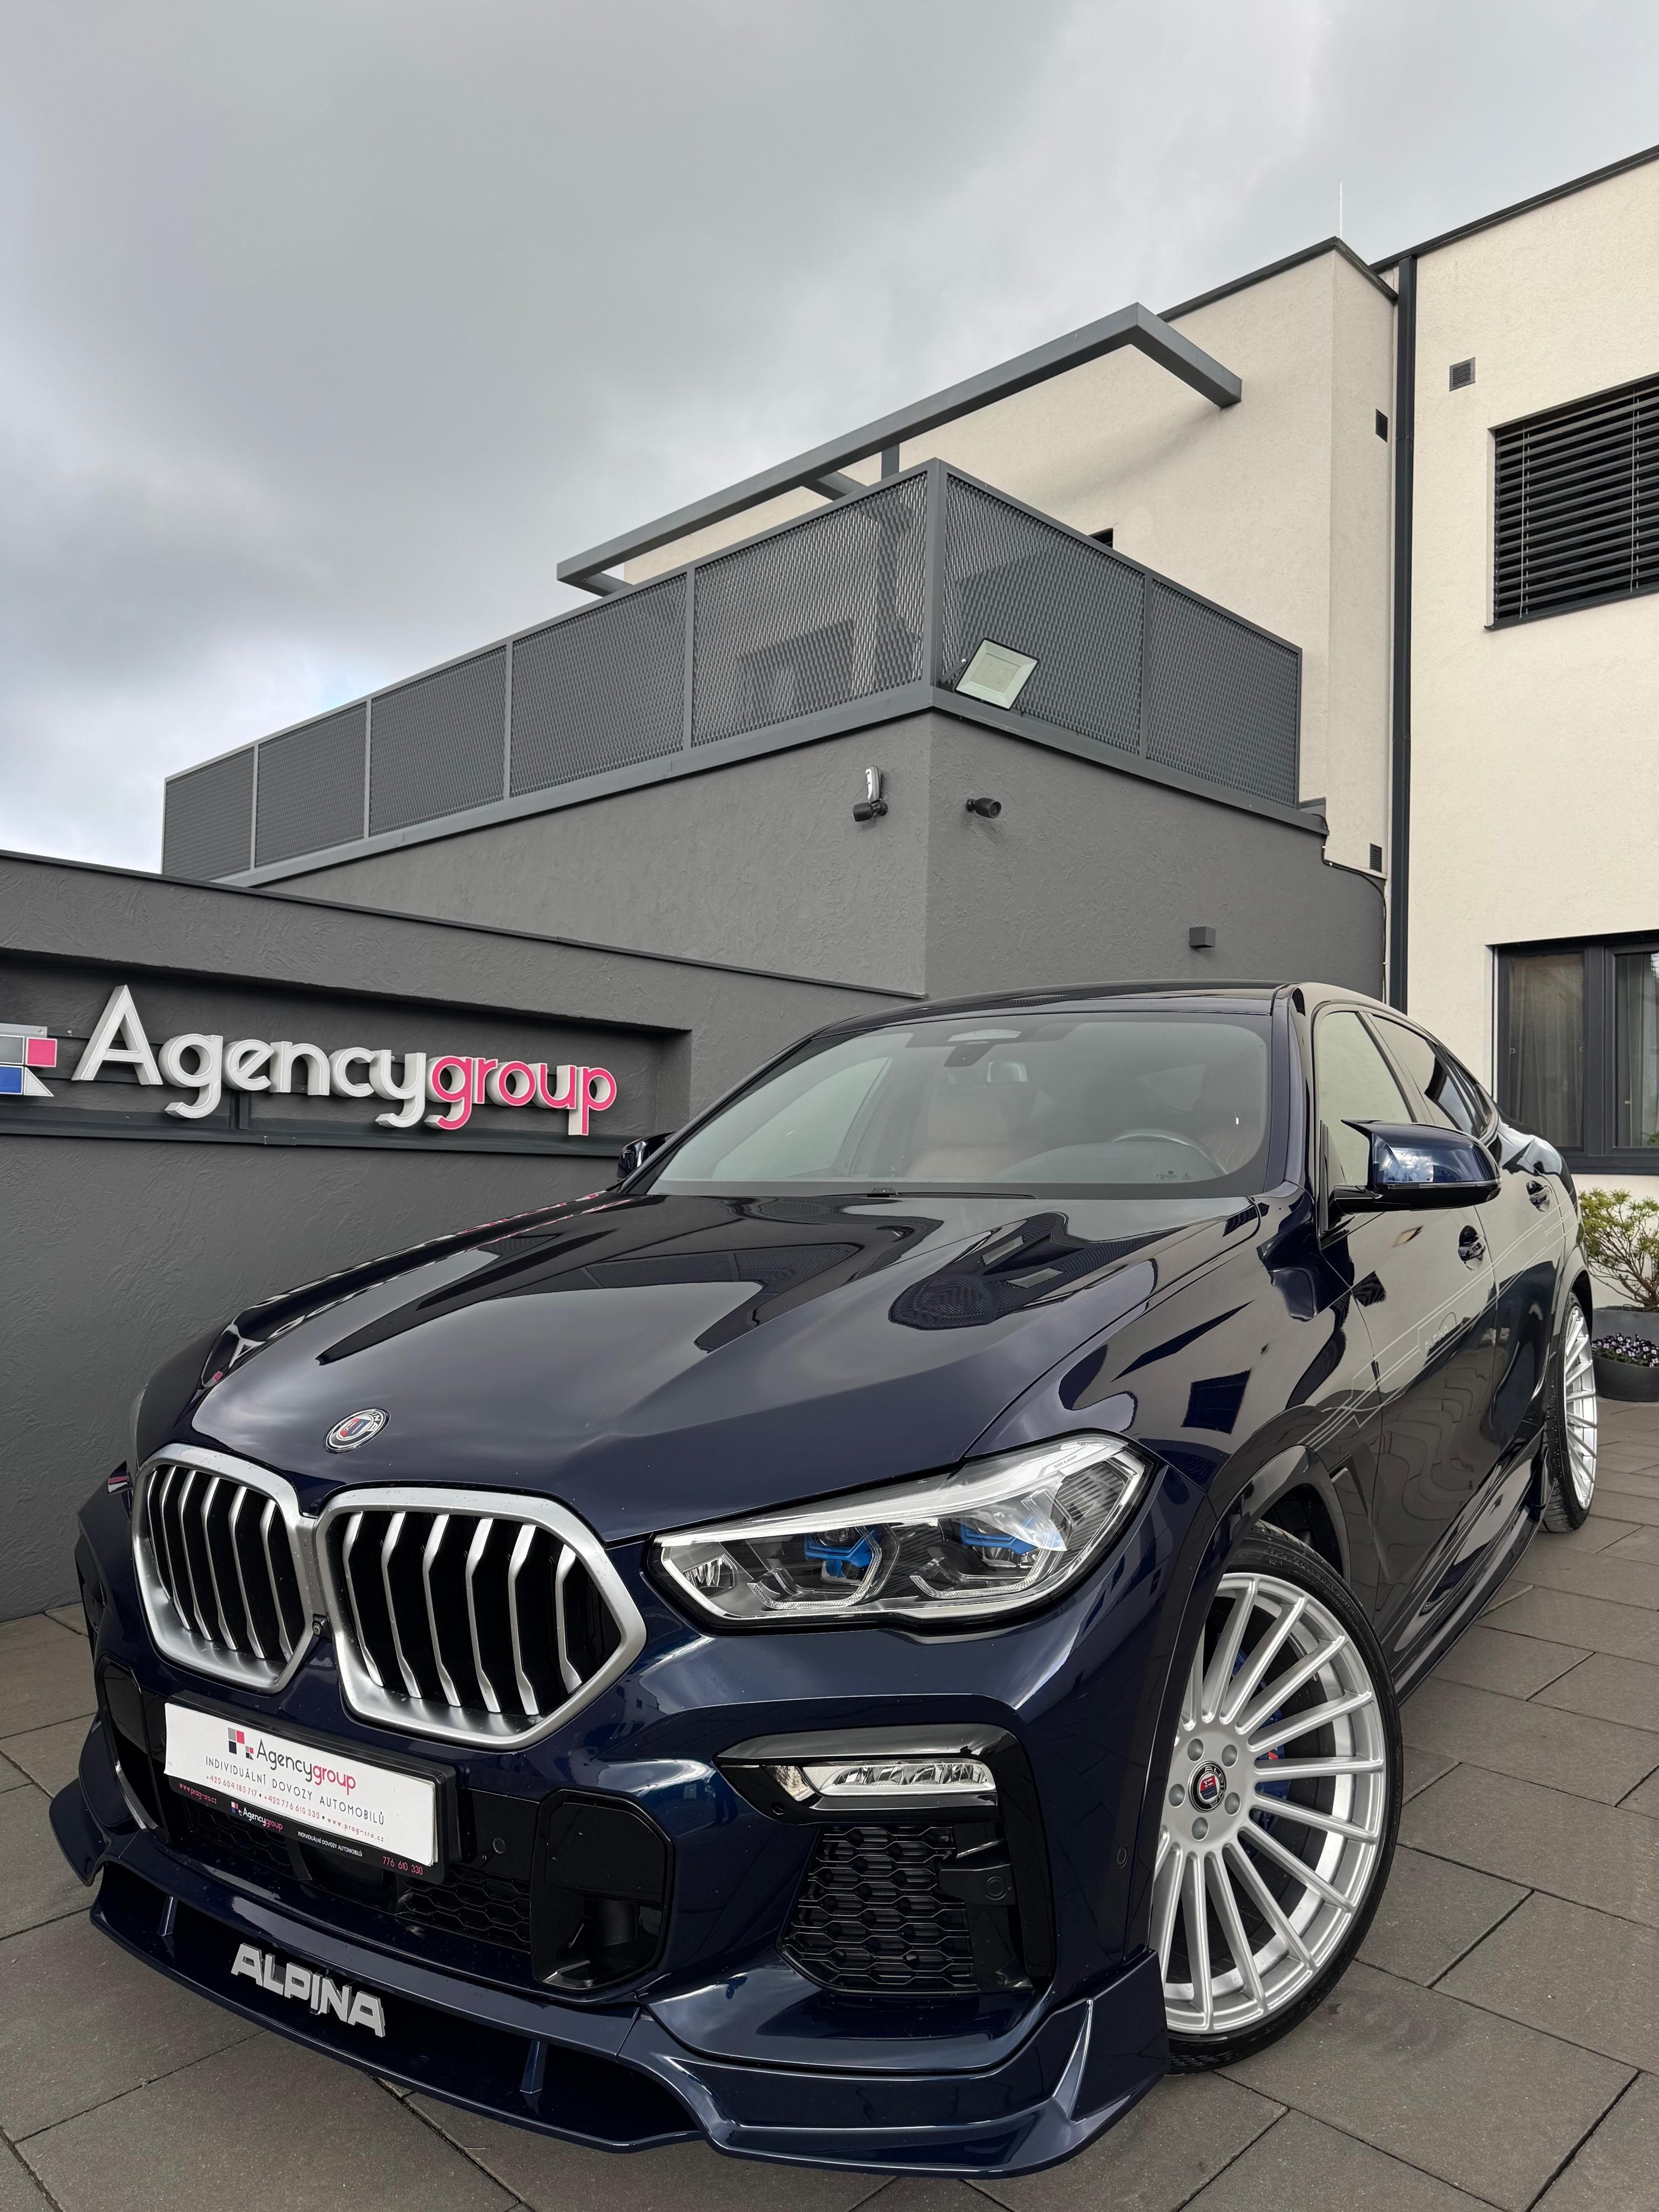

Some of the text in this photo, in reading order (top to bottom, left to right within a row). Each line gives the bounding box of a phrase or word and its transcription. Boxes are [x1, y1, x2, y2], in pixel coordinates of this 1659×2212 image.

[71, 984, 617, 1136] Agencygroup
[1425, 1325, 1449, 1353] ALPINA
[206, 1756, 384, 1825] INDIVIDUÁLNÍ DOVOZY AUTOMOBILŮ
[257, 1738, 356, 1795] Agencygroup
[1205, 1766, 1224, 1807] ALPINA
[179, 1783, 217, 1804] www.prag-sro.cz
[243, 1807, 283, 1832] Agencygroup
[322, 1839, 338, 1849] DOVOZY
[338, 1845, 362, 1857] AUTOMOBILŮ
[383, 1856, 395, 1867] 776
[398, 1862, 408, 1871] 610
[411, 1864, 423, 1875] 330
[206, 1775, 384, 1842] +420 604 180 717 +420 776 610 330 www.prag-sro.cz
[231, 1943, 385, 2038] ALPINA
